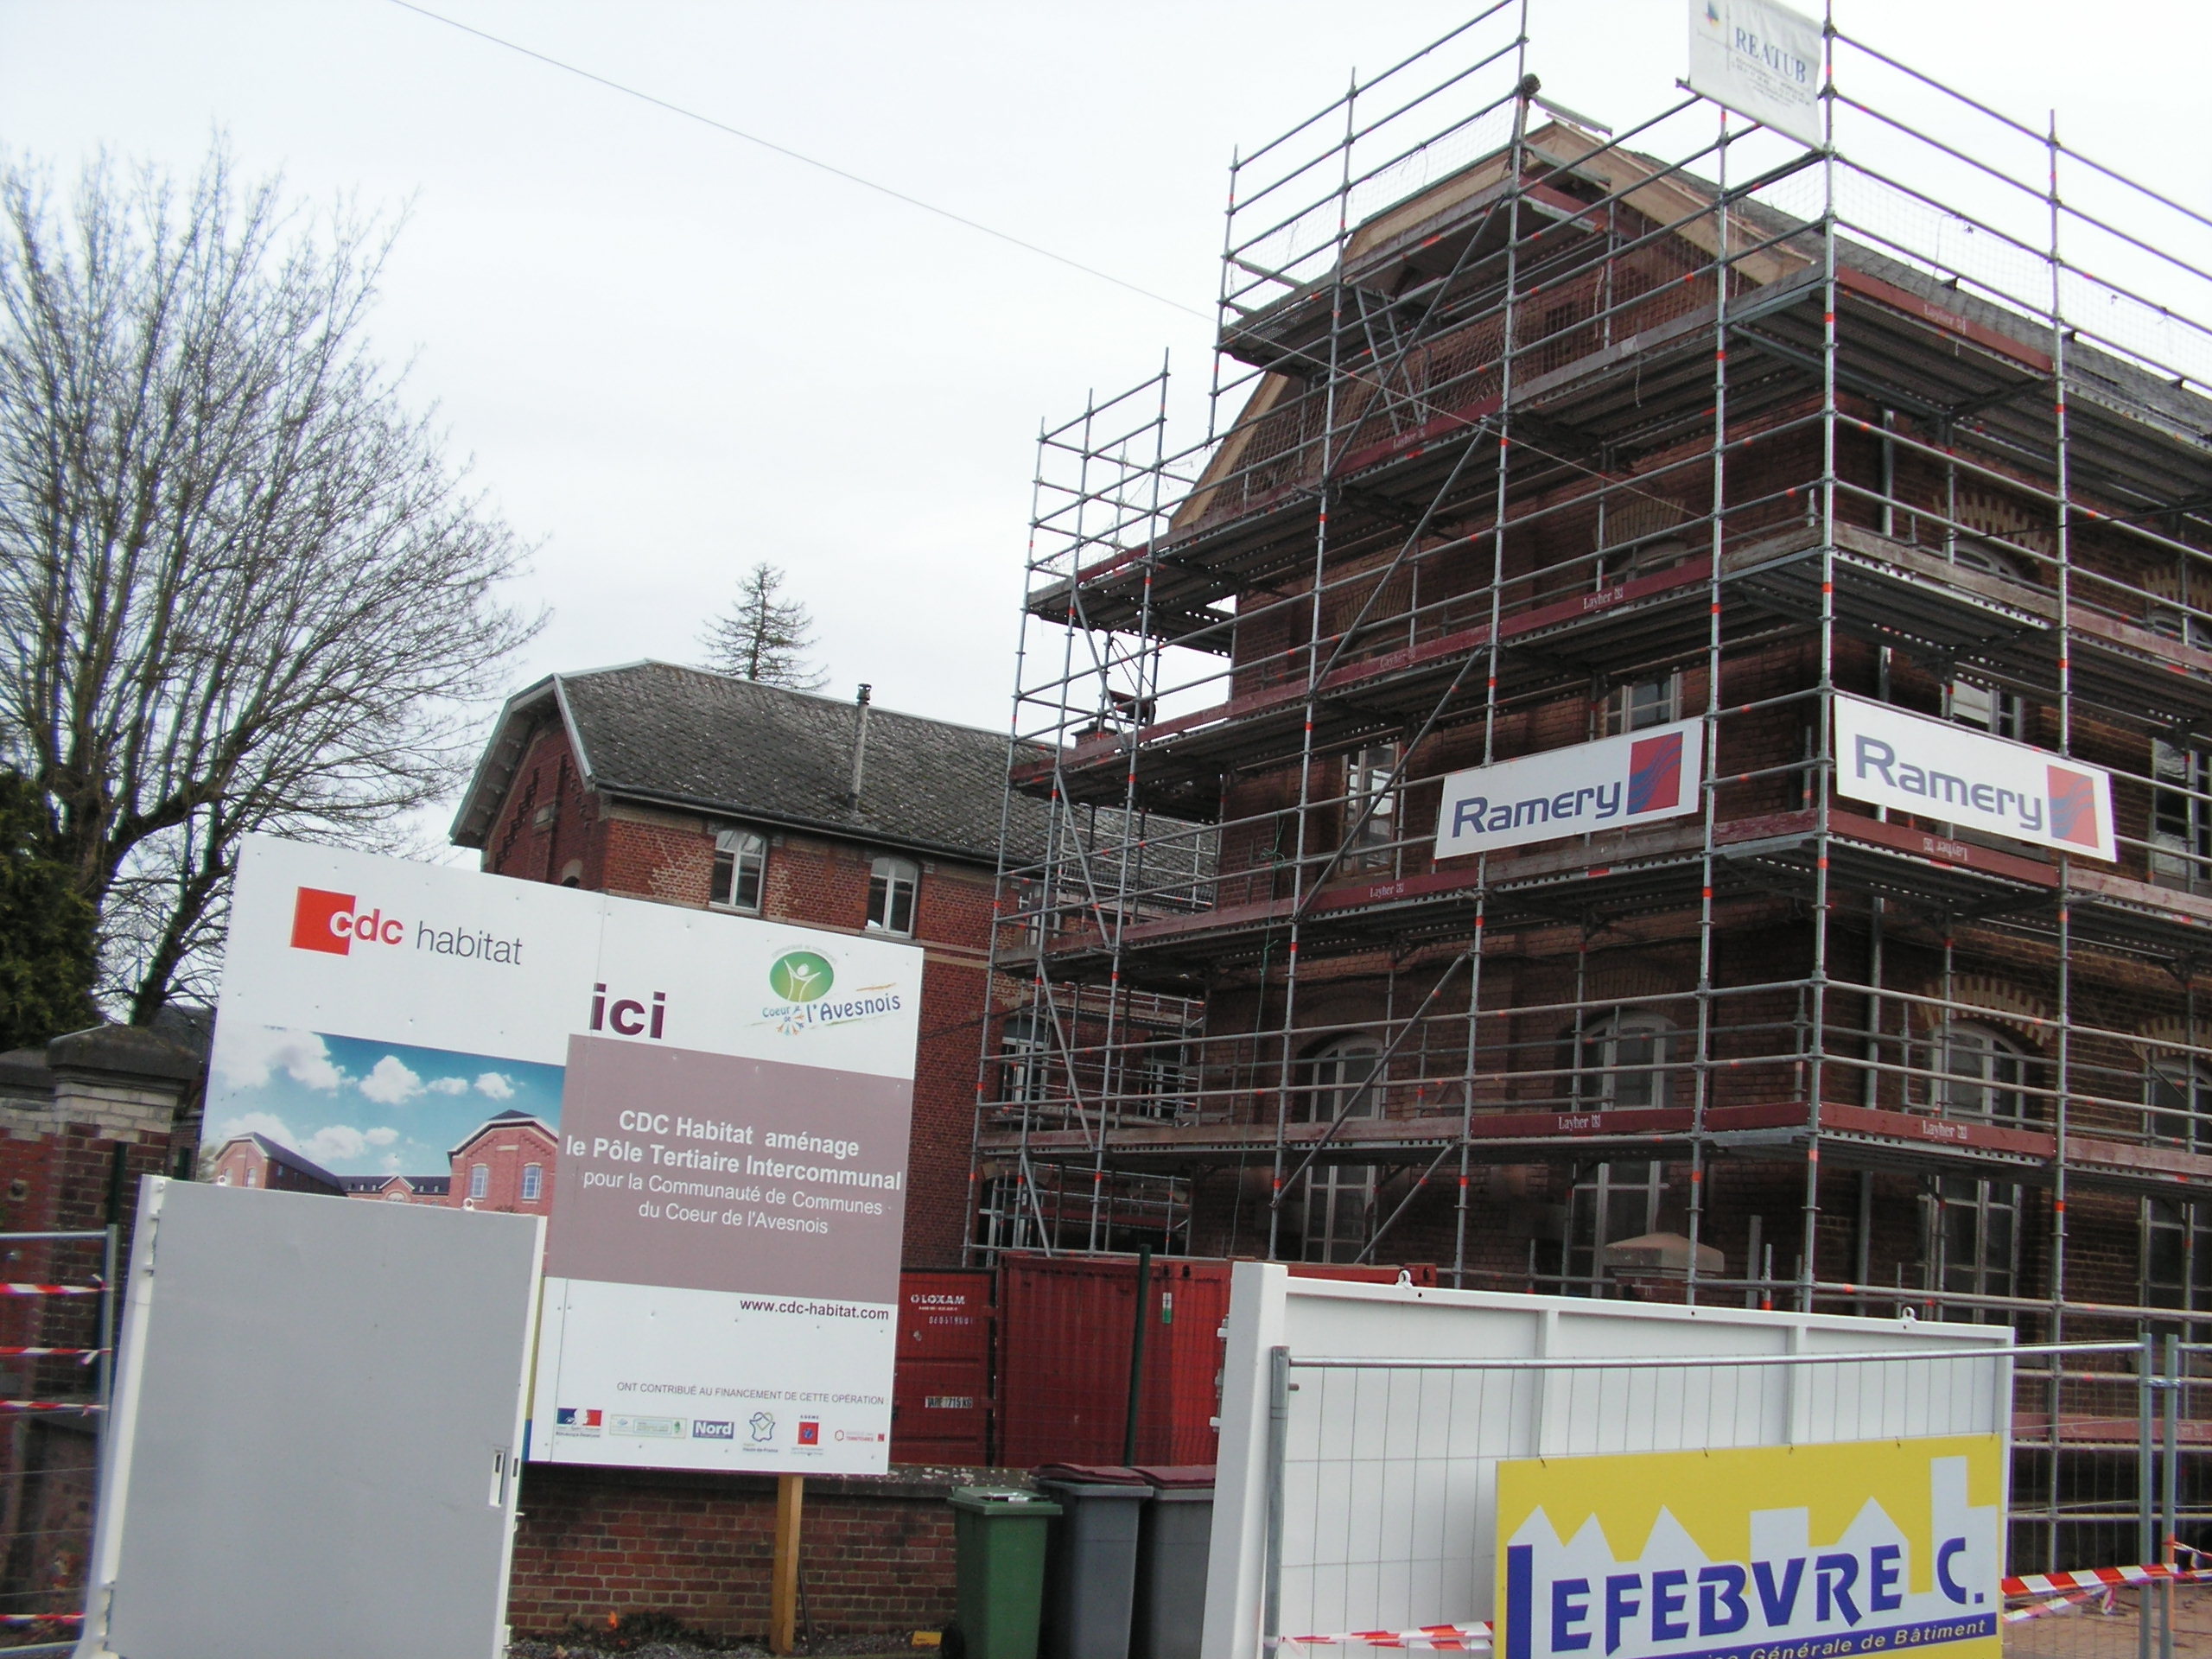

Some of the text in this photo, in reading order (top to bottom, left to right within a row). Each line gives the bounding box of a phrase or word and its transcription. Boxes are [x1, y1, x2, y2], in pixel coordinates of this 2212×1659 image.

[1735, 27, 1807, 84] REATUB
[1584, 592, 1612, 609] Layher
[1855, 734, 2041, 831] Ramery
[1452, 781, 1621, 838] Ramery
[1370, 886, 1394, 898] Layher
[329, 908, 523, 965] cdc habitat
[589, 982, 667, 1039] ici
[762, 1006, 790, 1018] Coeur
[806, 993, 900, 1023] l'Avesnois
[620, 1109, 859, 1160] CDC Habitat aménage
[1558, 1116, 1589, 1131] Layher
[1923, 1120, 1955, 1138] Layher
[566, 1135, 901, 1191] le Pôle Tertiaire Intercommunal
[583, 1172, 882, 1216] pour la Communauté de Communes
[639, 1200, 828, 1234] du Coeur de l'Avesnois
[740, 1299, 889, 1320] www.cdc-habitat.com
[921, 1294, 965, 1305] LOXAM
[616, 1382, 638, 1391] ONT
[640, 1382, 696, 1395] CONTRIBUÉ
[699, 1387, 713, 1395] AU
[715, 1388, 783, 1399] FINANCEMENT
[785, 1391, 797, 1401] DE
[799, 1392, 829, 1402] CETTE
[696, 1421, 732, 1435] Nord
[1936, 1536, 1985, 1605] C.
[1751, 1619, 1985, 1659] Générale de Bâtiment
